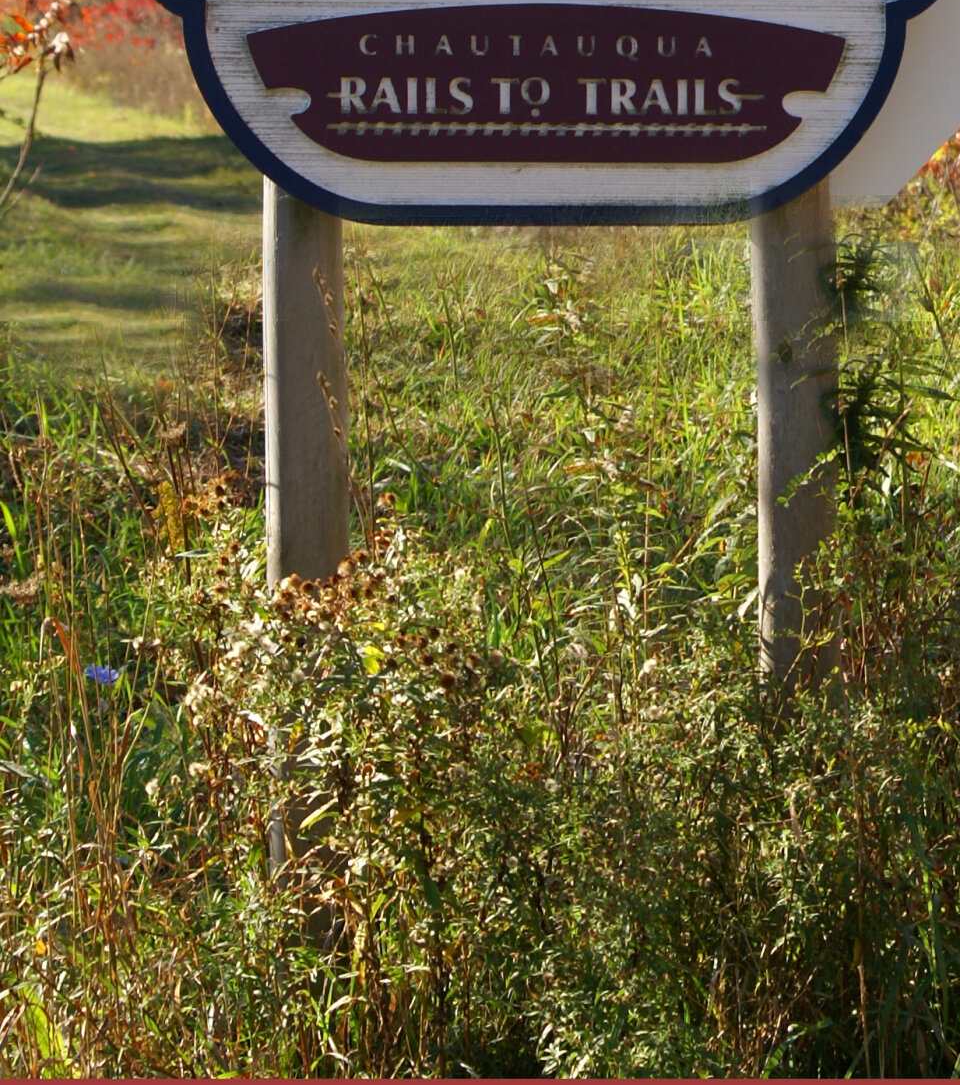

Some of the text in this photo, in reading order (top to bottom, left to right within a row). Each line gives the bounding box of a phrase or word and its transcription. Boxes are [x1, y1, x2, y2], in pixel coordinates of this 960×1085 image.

[359, 33, 713, 60] CHAUTAUQUA
[339, 76, 741, 118] RAILS TO TRAILS
